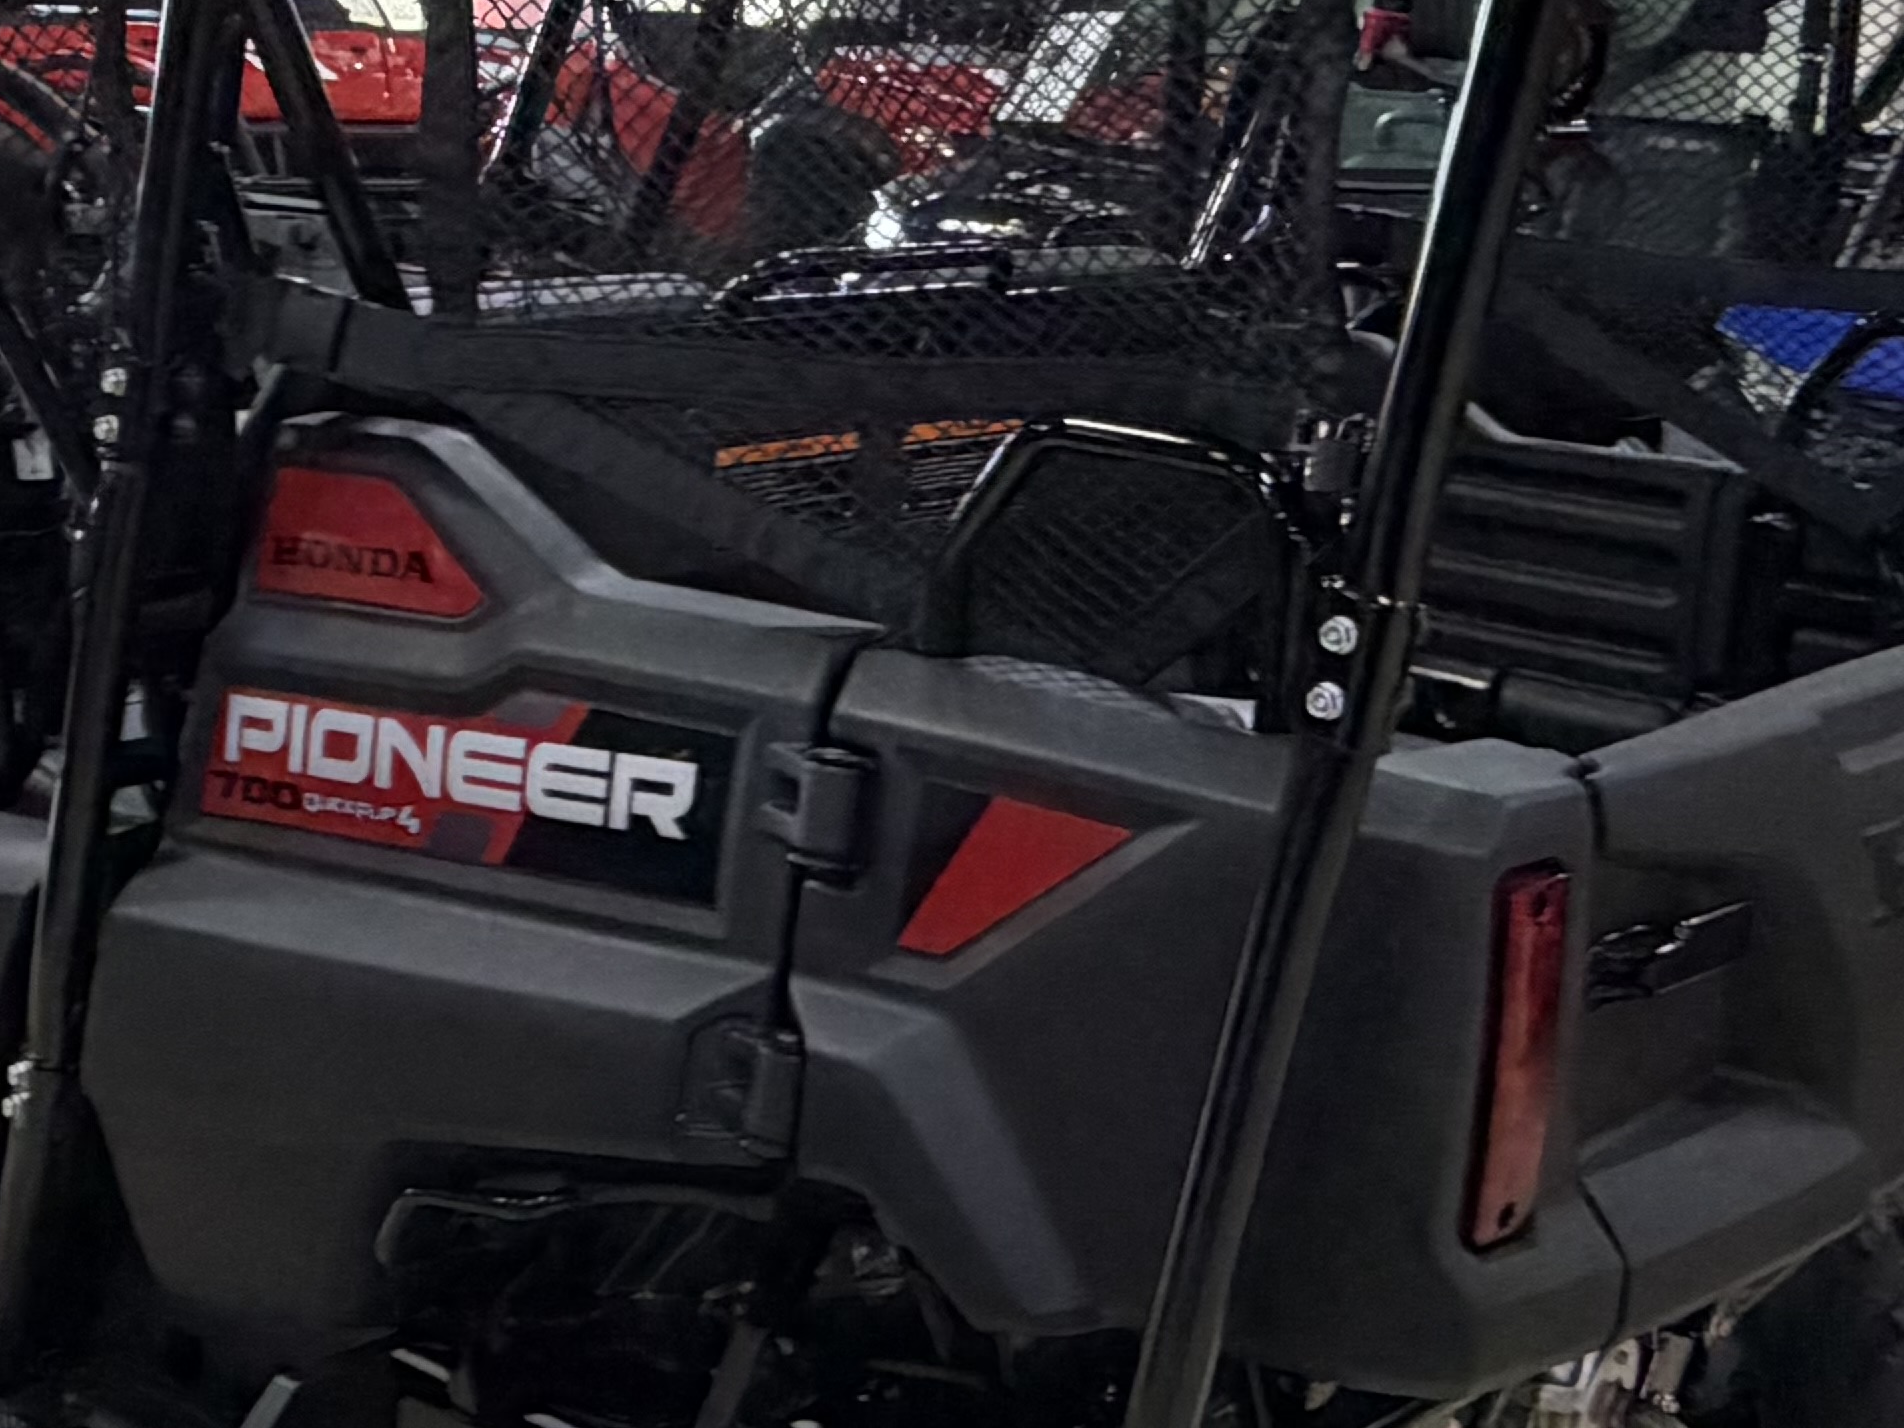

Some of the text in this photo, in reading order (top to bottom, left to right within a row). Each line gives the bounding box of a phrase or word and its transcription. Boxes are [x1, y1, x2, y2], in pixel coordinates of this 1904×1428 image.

[270, 534, 435, 585] HONDA
[208, 769, 303, 811] 700
[222, 693, 700, 841] PIONEER
